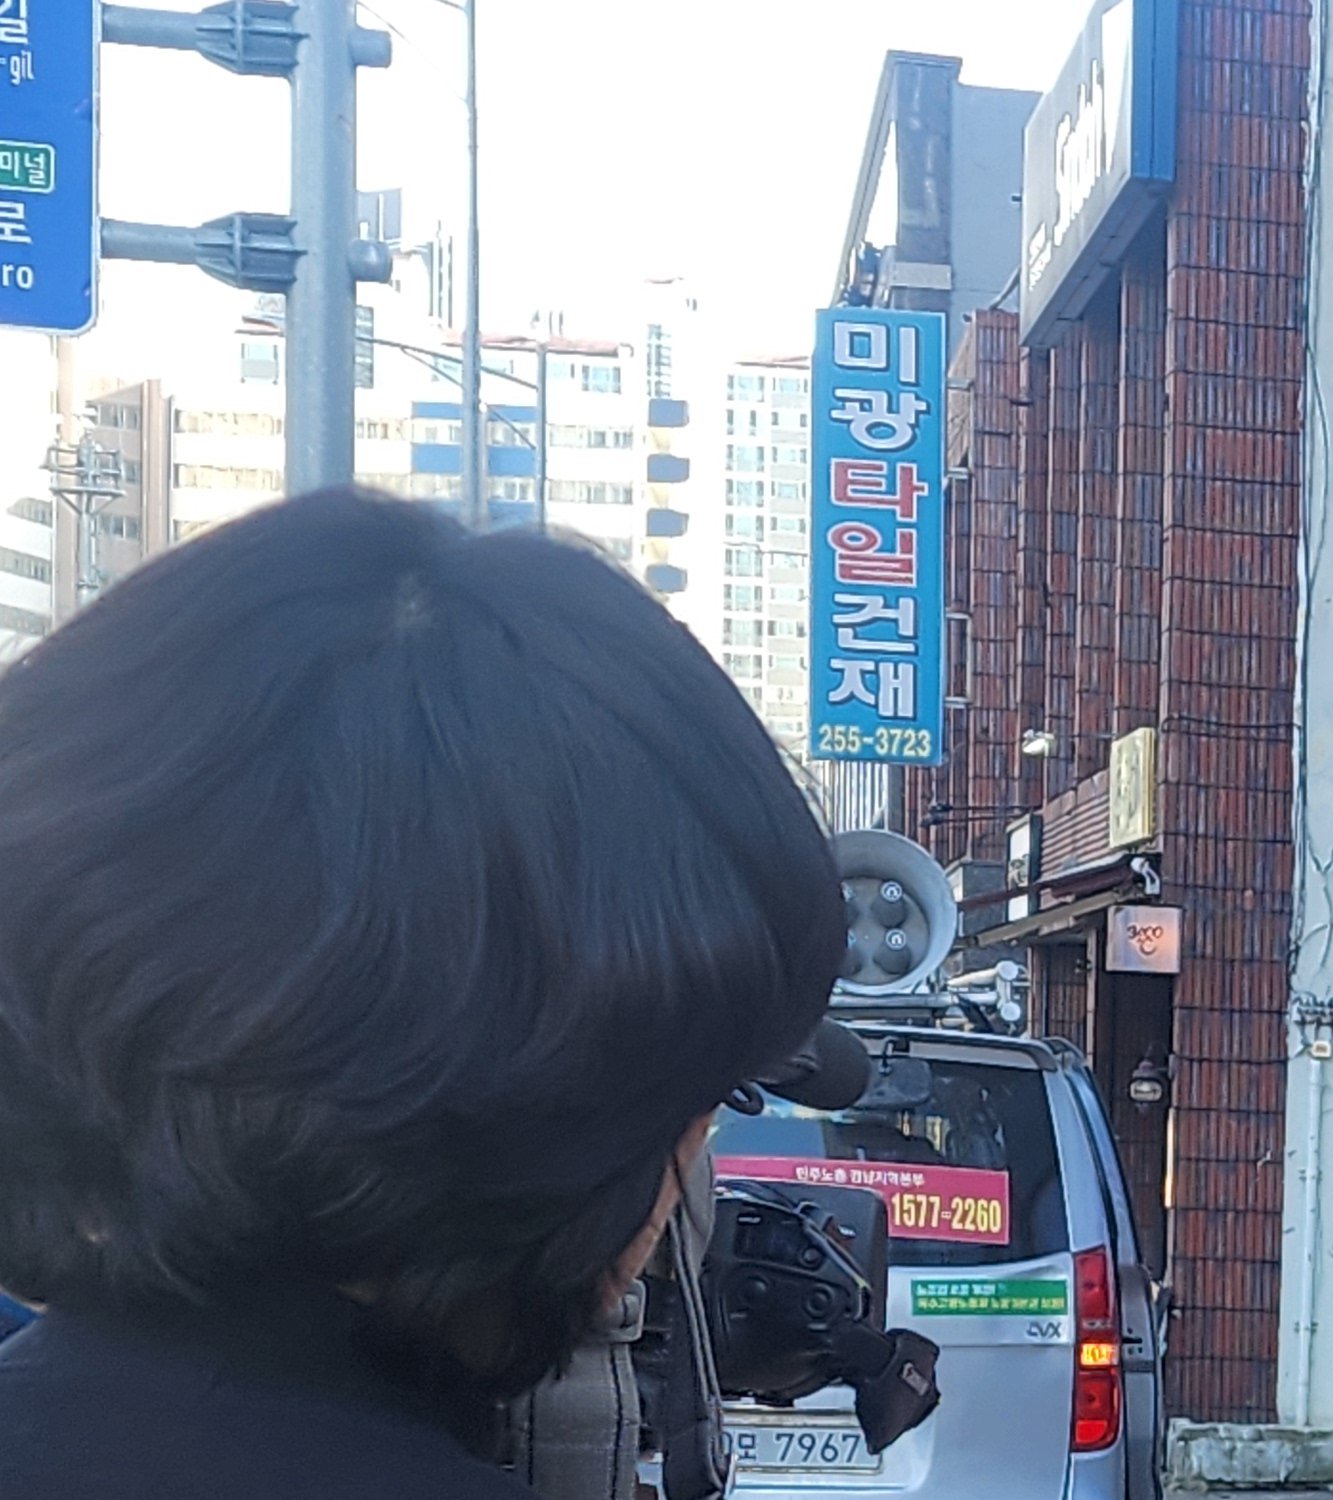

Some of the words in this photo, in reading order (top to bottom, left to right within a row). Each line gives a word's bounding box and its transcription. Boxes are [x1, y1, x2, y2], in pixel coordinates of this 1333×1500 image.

[827, 320, 931, 721] 미광타일건재
[818, 723, 933, 759] 255-3723
[795, 1166, 848, 1184] 민주노총
[891, 1191, 1002, 1234] 1577-2260
[775, 1433, 861, 1463] 7967
